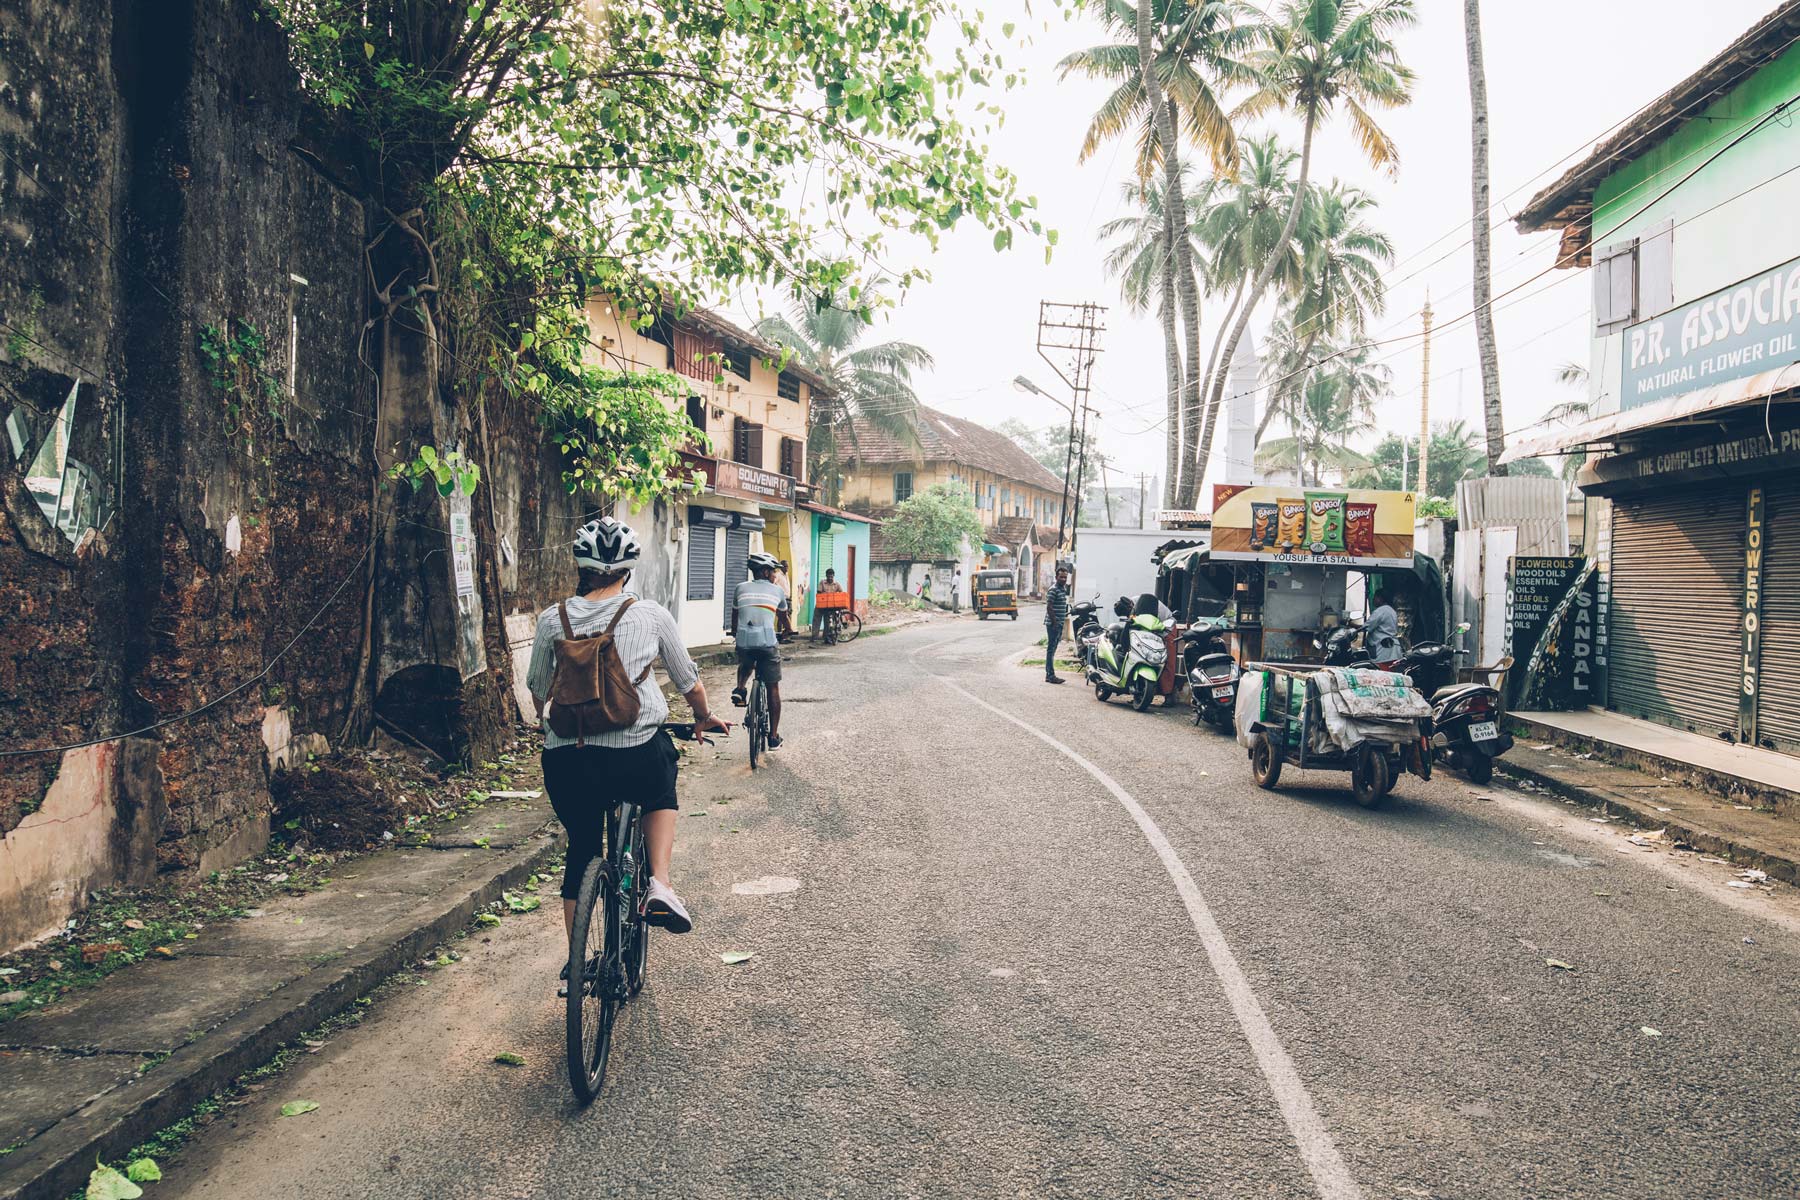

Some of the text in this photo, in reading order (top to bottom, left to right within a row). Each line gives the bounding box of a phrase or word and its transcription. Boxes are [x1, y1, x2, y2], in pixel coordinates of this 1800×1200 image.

[1631, 265, 1800, 369] P.R. ASSOCIA
[1638, 333, 1797, 395] NATURAL FLOWER OIL
[1637, 457, 1654, 476] THE
[1657, 445, 1715, 473] COMPLETE
[1716, 433, 1778, 464] NATURAL
[738, 467, 780, 489] SOUVENIR
[742, 482, 775, 496] COLLECTIONS
[1217, 487, 1233, 502] NEW
[1313, 499, 1341, 513] BINGO!
[1347, 507, 1371, 520] BINGO!
[1273, 553, 1357, 565] YOUSUF TEA STALL
[1516, 559, 1575, 569] FLOWER OILS
[1516, 569, 1566, 578] WOOD OILS
[1515, 577, 1560, 586] ESSENTIAL
[1515, 586, 1536, 594] OILS
[1515, 595, 1549, 603] LEAF OILS
[1514, 603, 1548, 612] SEED OILS
[1514, 612, 1540, 620] AROMA
[1514, 620, 1531, 630] OILS
[1573, 591, 1592, 691] SANDAL
